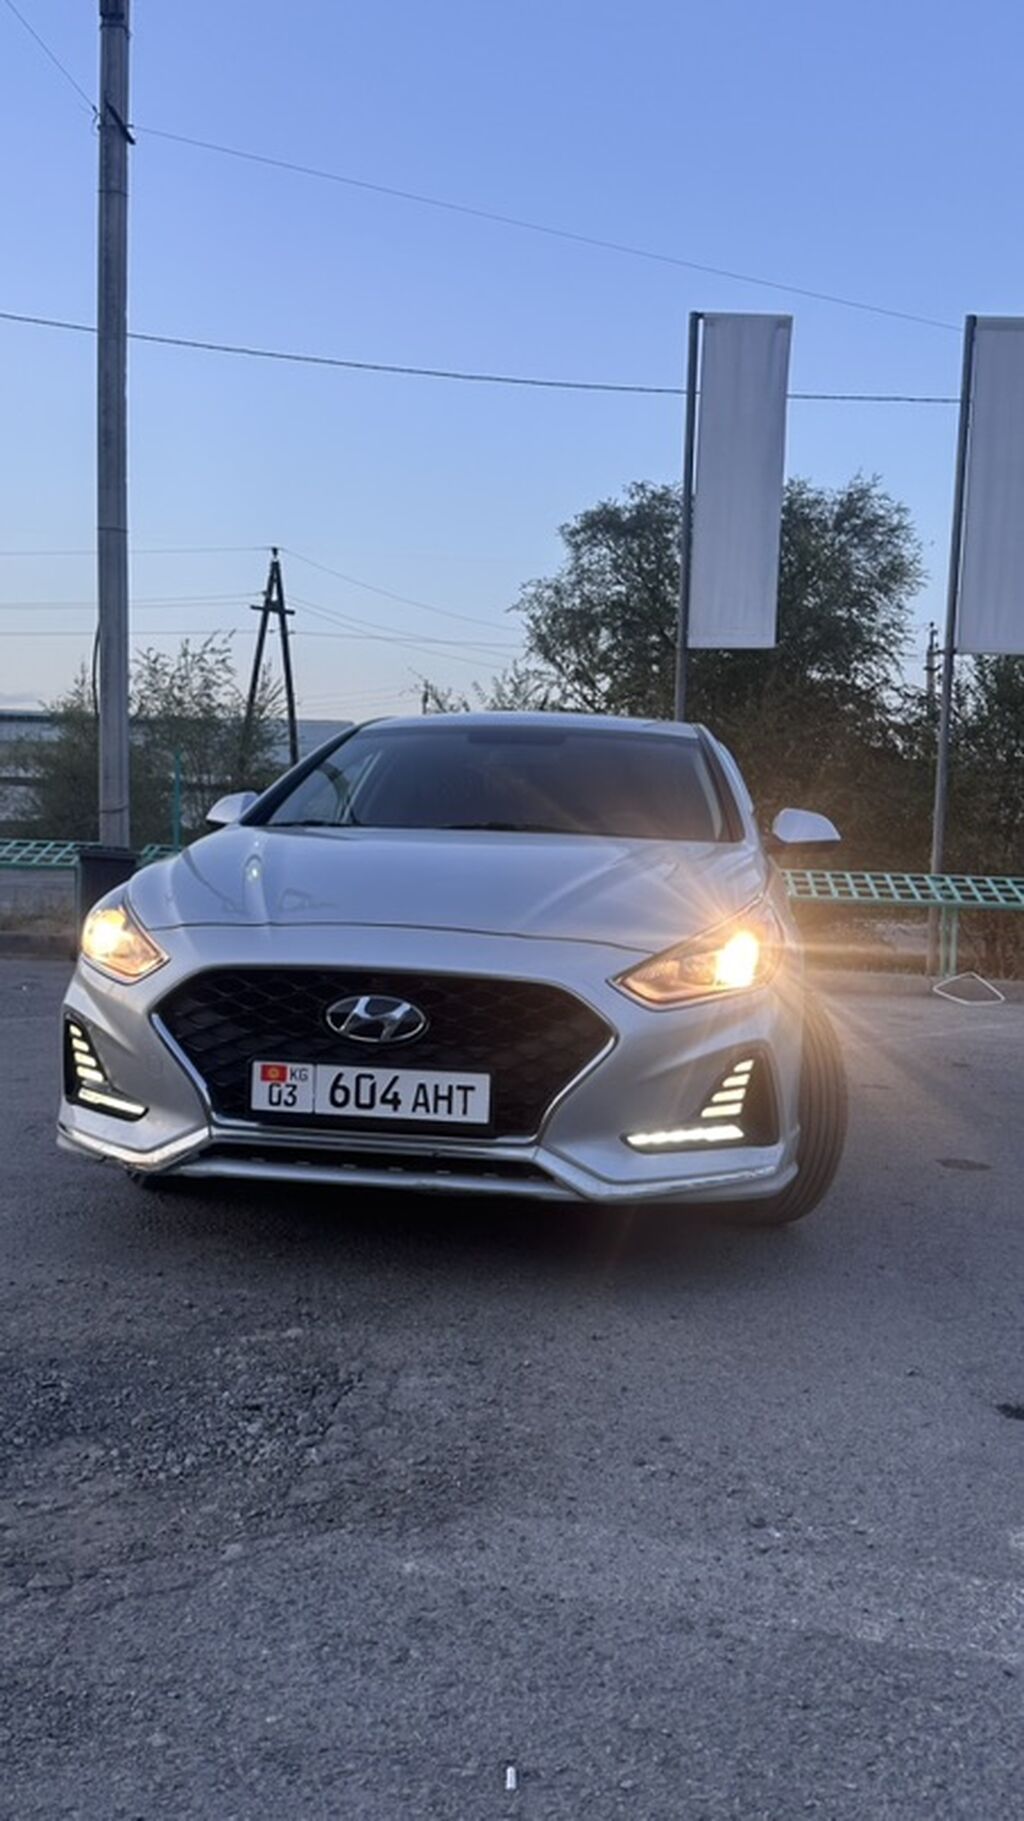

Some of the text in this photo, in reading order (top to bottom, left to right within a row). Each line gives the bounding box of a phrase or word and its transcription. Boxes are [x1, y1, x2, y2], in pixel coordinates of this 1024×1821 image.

[290, 1068, 308, 1081] KG
[268, 1083, 297, 1107] 03
[329, 1072, 476, 1116] 604 AHT
